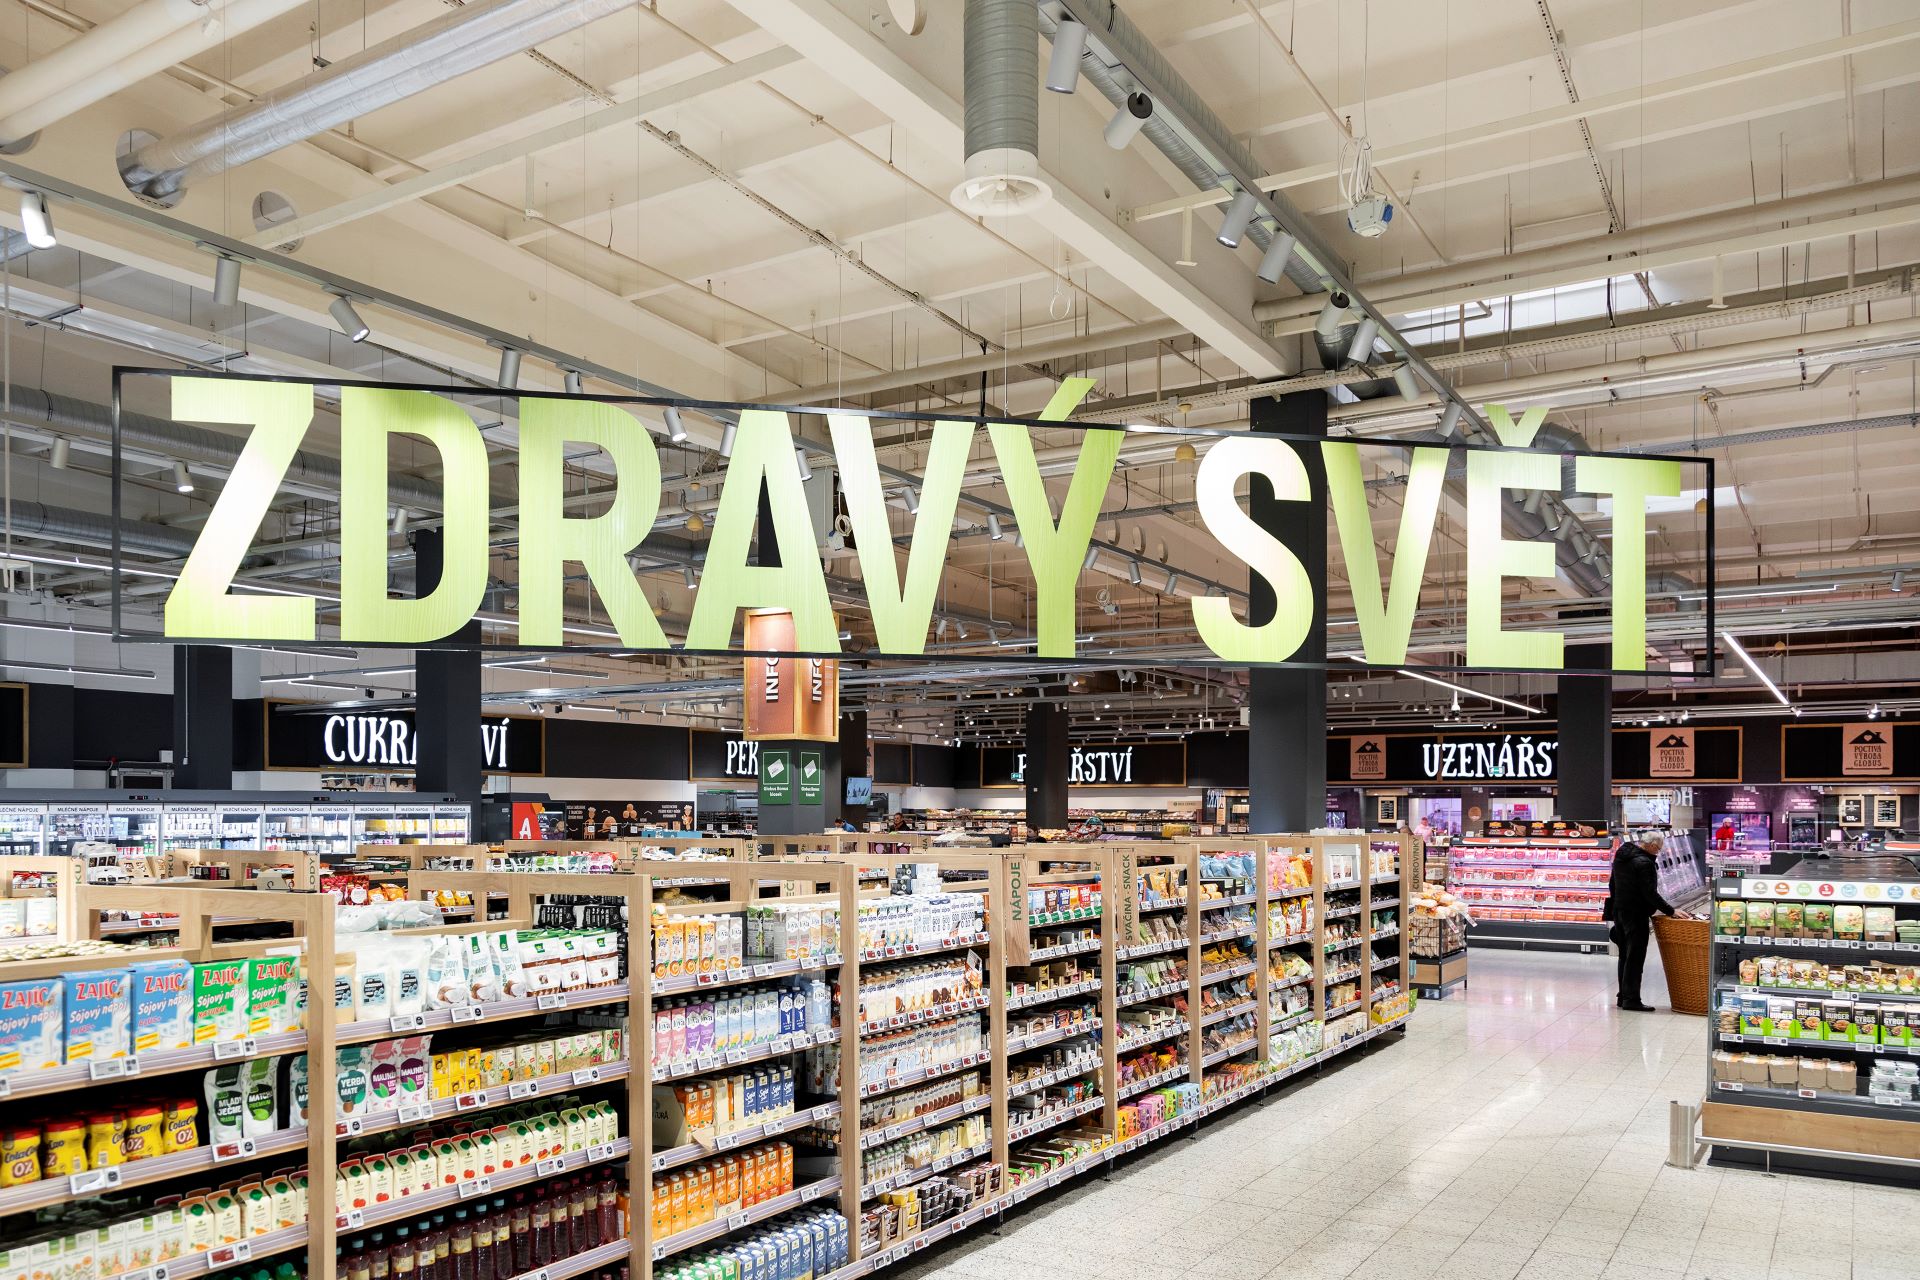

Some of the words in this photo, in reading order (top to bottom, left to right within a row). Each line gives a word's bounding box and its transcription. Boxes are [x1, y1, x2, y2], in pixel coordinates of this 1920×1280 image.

[164, 376, 1126, 660] ZDRAVÝ
[1191, 404, 1681, 671] SVĚT
[1423, 735, 1558, 778] UZENÁŘS
[1122, 854, 1131, 890] SNACK
[1010, 862, 1022, 921] NÁPOJE
[202, 966, 239, 988] ZAJÍC
[256, 961, 291, 981] ZAJÍC
[75, 978, 117, 1001] ZAJÍC
[144, 971, 183, 994] ZAJÍC
[2, 986, 48, 1010] ZAJÍC
[1797, 1008, 1820, 1017] BURGER
[340, 1076, 366, 1089] YERBA
[340, 1086, 358, 1097] MATE
[126, 1138, 143, 1151] 0%
[176, 1128, 193, 1143] 0%
[13, 1160, 33, 1176] 0%
